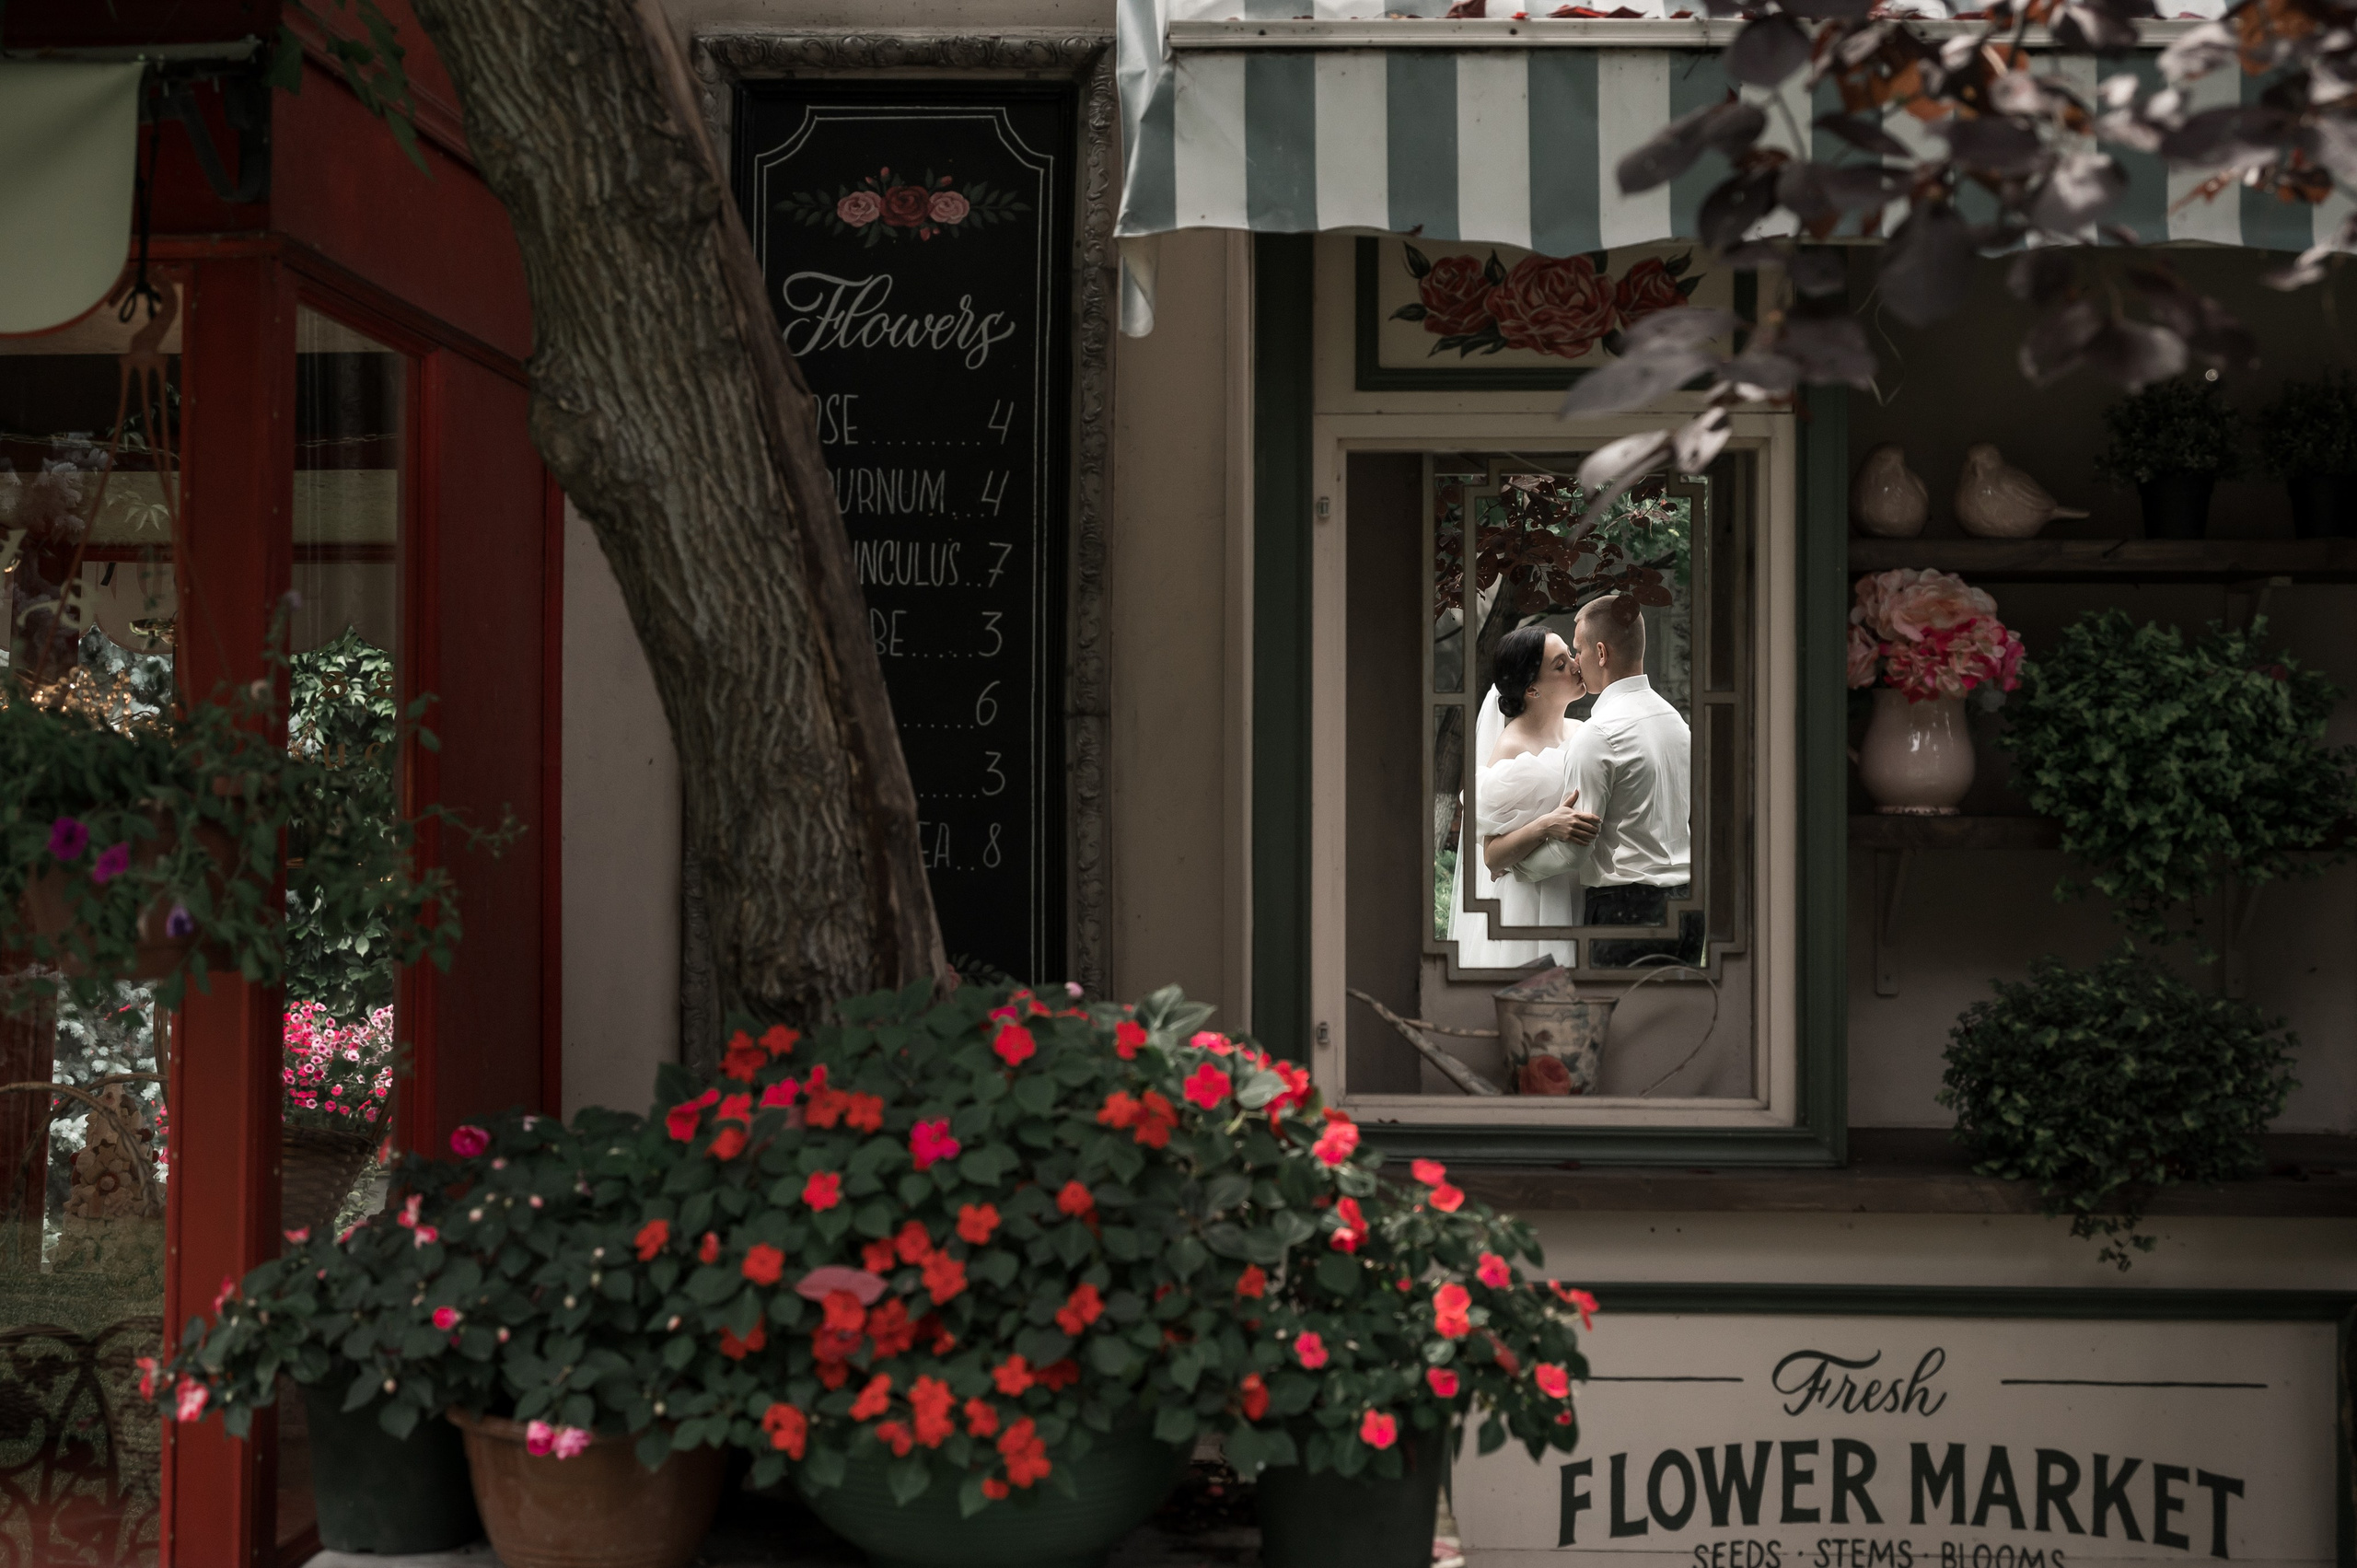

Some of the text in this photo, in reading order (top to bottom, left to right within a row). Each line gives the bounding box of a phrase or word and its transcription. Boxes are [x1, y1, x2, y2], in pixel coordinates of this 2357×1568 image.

[782, 271, 1016, 370] Flowers
[987, 398, 1015, 446] 4
[826, 467, 1011, 517] URNUM 4
[853, 539, 1014, 589] NCULUS 7
[978, 611, 1004, 657] 3
[976, 679, 1002, 726] 6
[981, 751, 1006, 796] 3
[982, 822, 1002, 869] 8
[1772, 1347, 1947, 1417] Fresh
[1557, 1438, 2245, 1560] FLOWER MARKET
[1693, 1538, 2065, 1568] SEEDS STEMS BLOOMS
